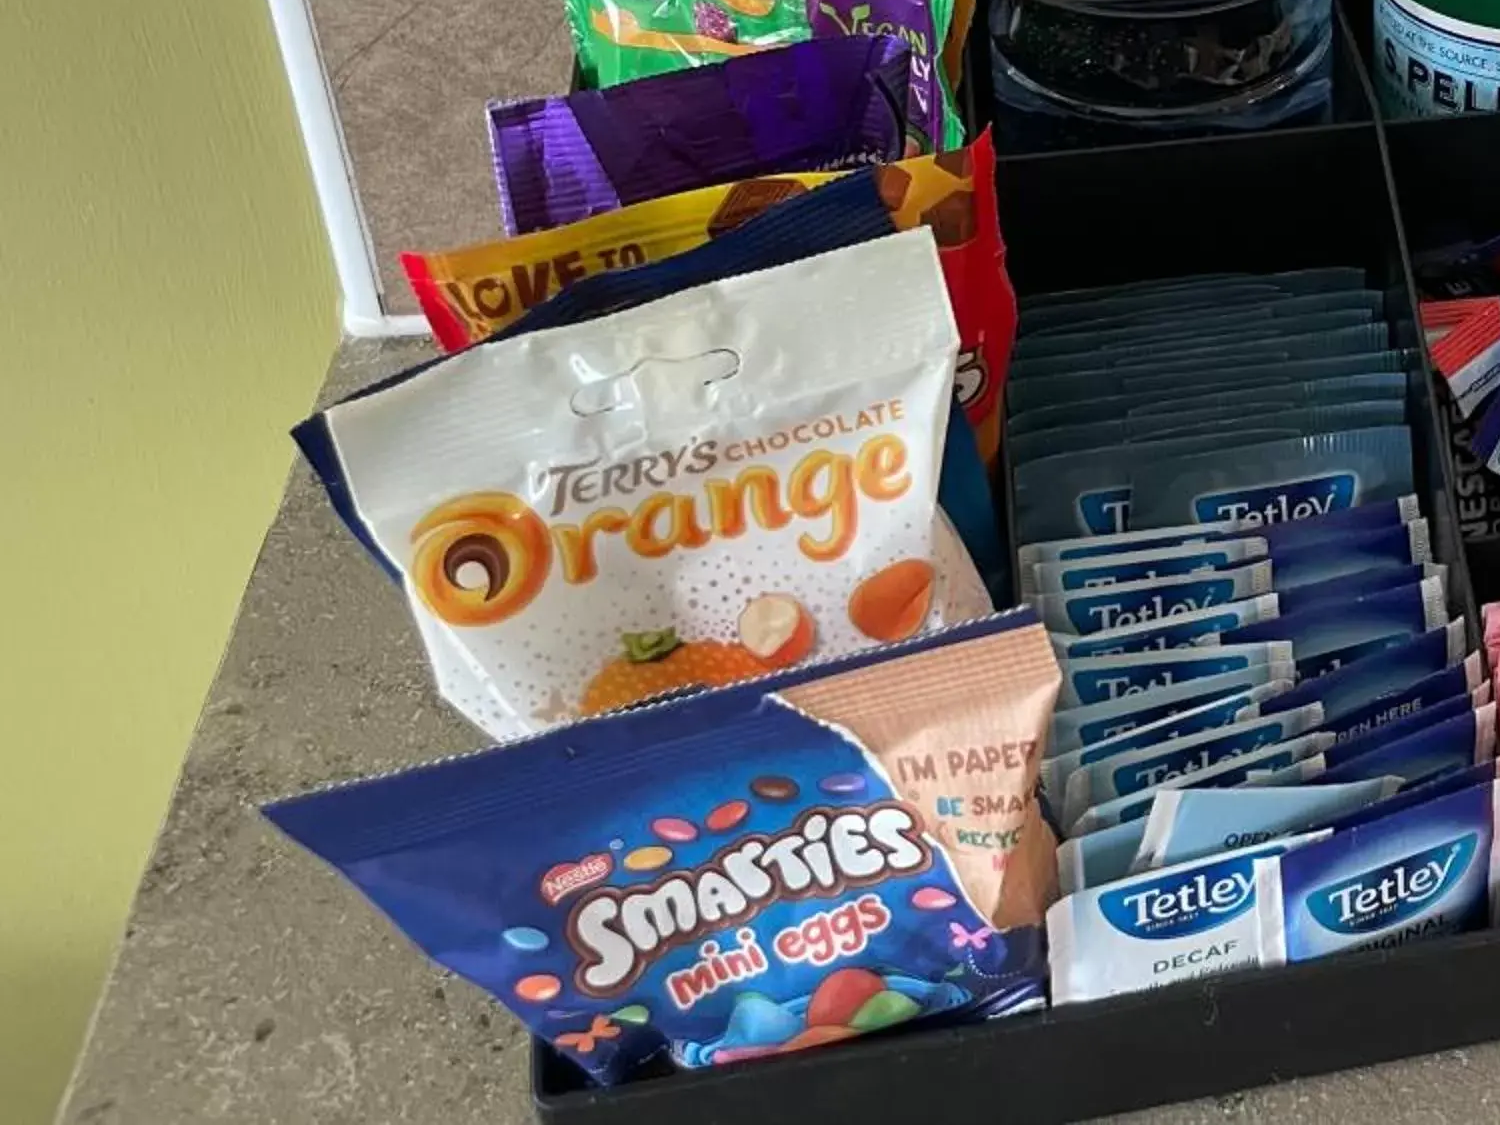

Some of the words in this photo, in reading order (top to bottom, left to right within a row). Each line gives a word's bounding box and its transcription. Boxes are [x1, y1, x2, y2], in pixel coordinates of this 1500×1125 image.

[446, 250, 588, 319] LOVE
[537, 437, 718, 516] TERRY'S
[724, 398, 905, 463] CHOCOLATE
[409, 432, 914, 627] Orange
[1337, 719, 1372, 744] PEN
[1375, 696, 1422, 725] HERE
[897, 753, 938, 783] I'M
[936, 795, 965, 817] BE
[576, 807, 917, 987] SMARTIES
[1122, 872, 1257, 927] Tetley
[1328, 842, 1462, 924] Tetley
[668, 928, 768, 1009] mini
[775, 896, 890, 966] eggs
[1152, 939, 1240, 974] DECAF
